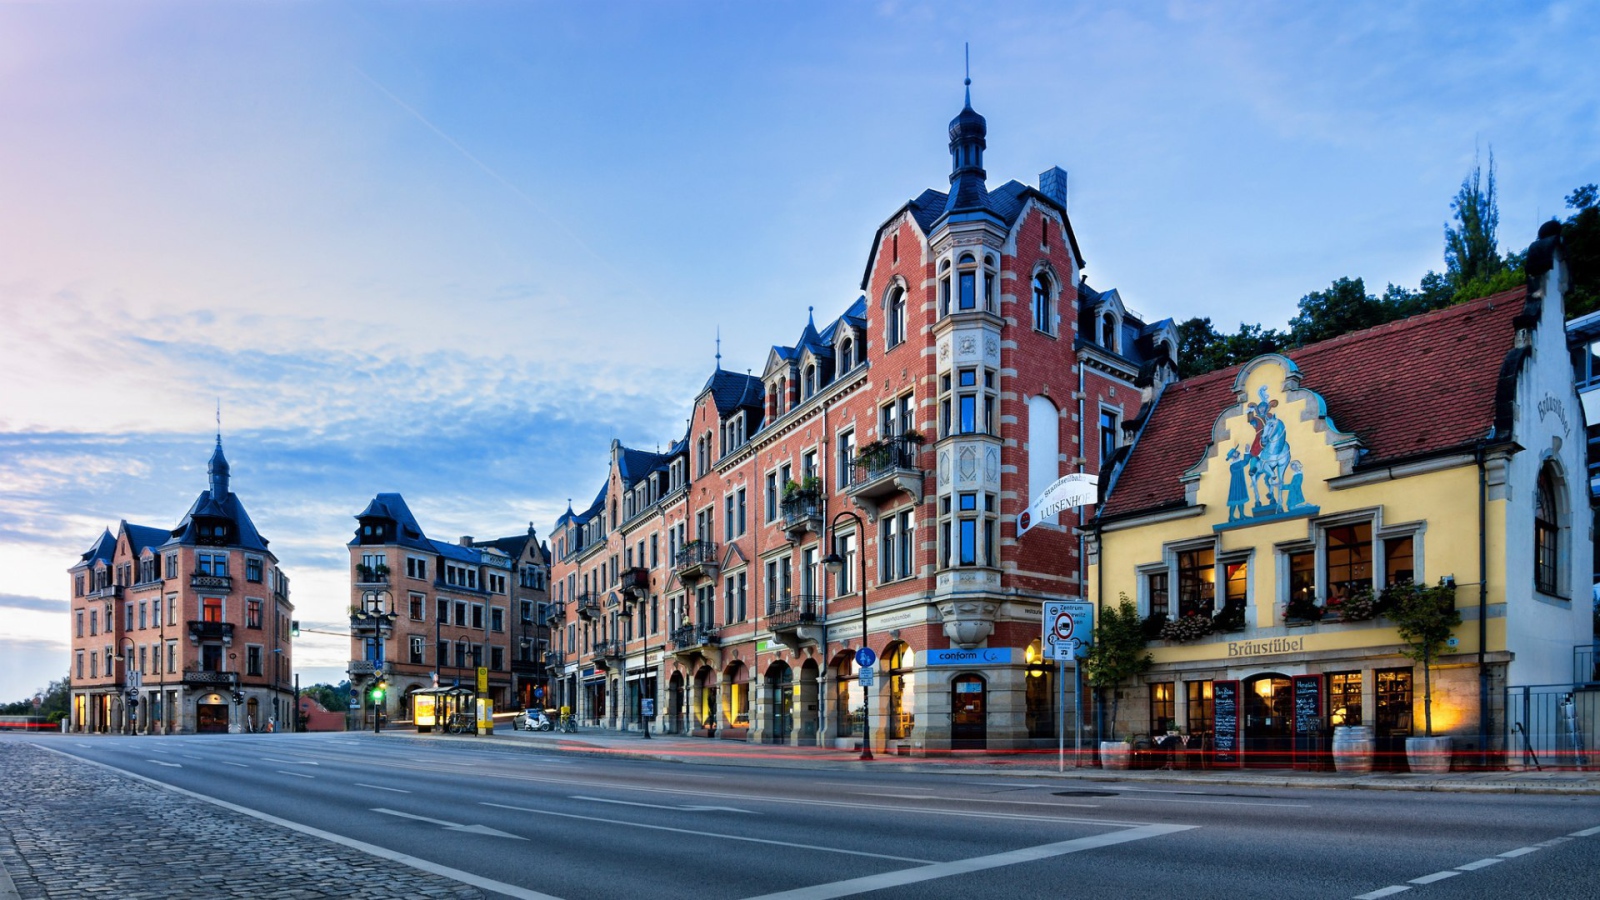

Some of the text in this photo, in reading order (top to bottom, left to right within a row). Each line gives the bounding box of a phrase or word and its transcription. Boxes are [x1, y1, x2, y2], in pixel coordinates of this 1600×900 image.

[1537, 392, 1571, 439] Bräustübel
[1040, 492, 1091, 520] LUISENHOF
[939, 651, 977, 661] conform
[1228, 636, 1304, 657] Bräustübel
